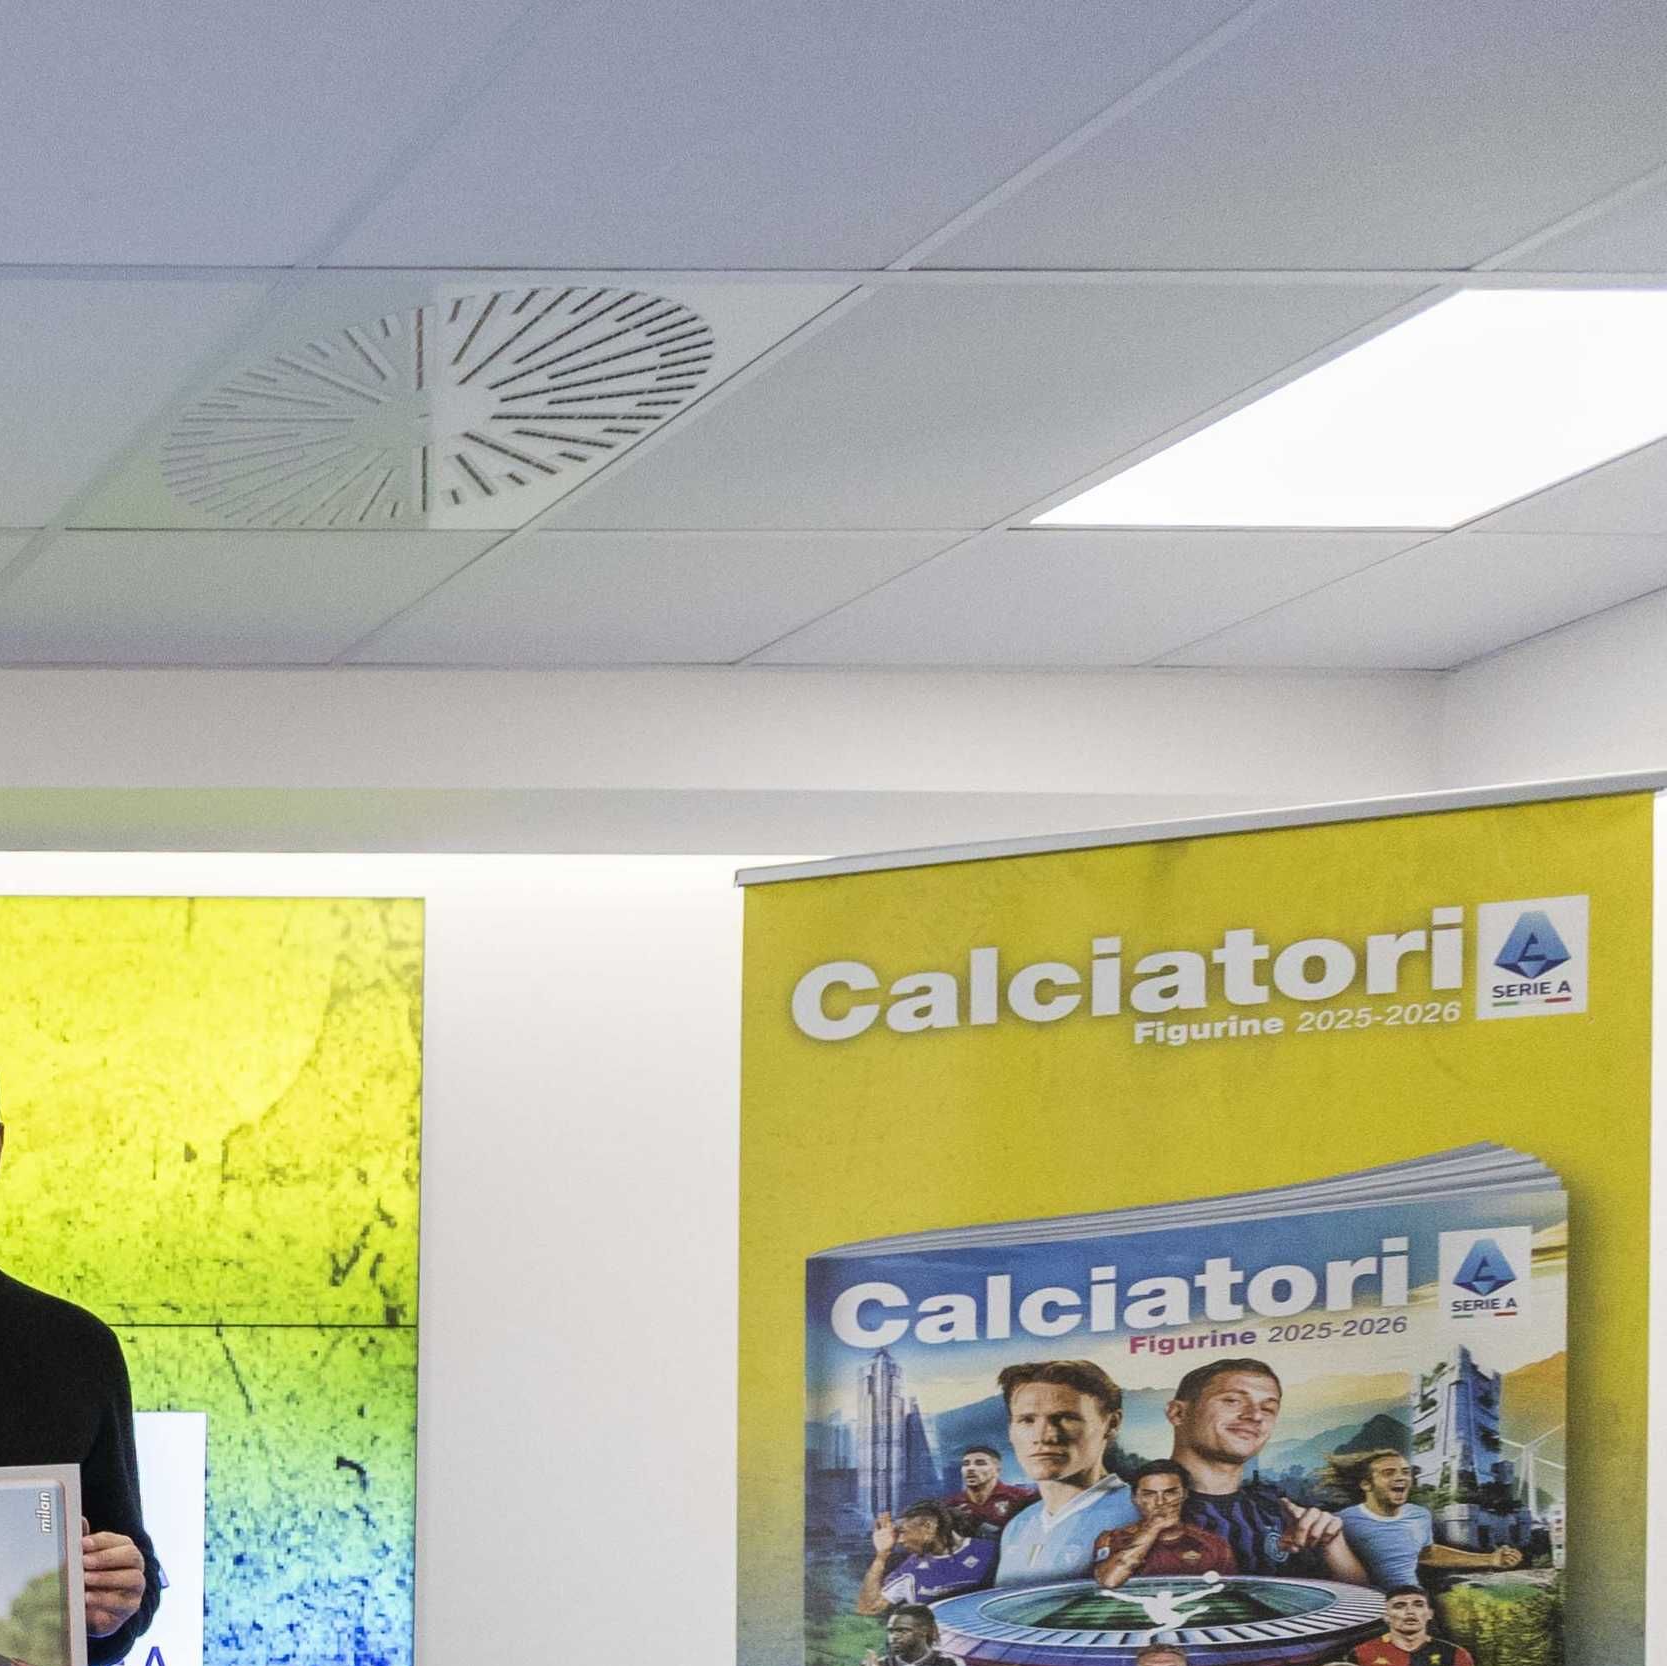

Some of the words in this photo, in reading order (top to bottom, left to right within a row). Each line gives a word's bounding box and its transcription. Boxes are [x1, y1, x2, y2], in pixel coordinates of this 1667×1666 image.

[791, 905, 1464, 1042] Calciatori
[1491, 980, 1551, 999] SERIE
[1555, 979, 1572, 995] A
[1133, 1014, 1285, 1047] Figurine
[1296, 1000, 1461, 1034] 2025-2026
[830, 1235, 1410, 1350] Calciatori
[1451, 1297, 1500, 1313] SERIE
[1504, 1296, 1518, 1309] A
[1129, 1328, 1257, 1356] Figurine
[1268, 1315, 1408, 1343] 2025-2026
[36, 1491, 51, 1532] milan
